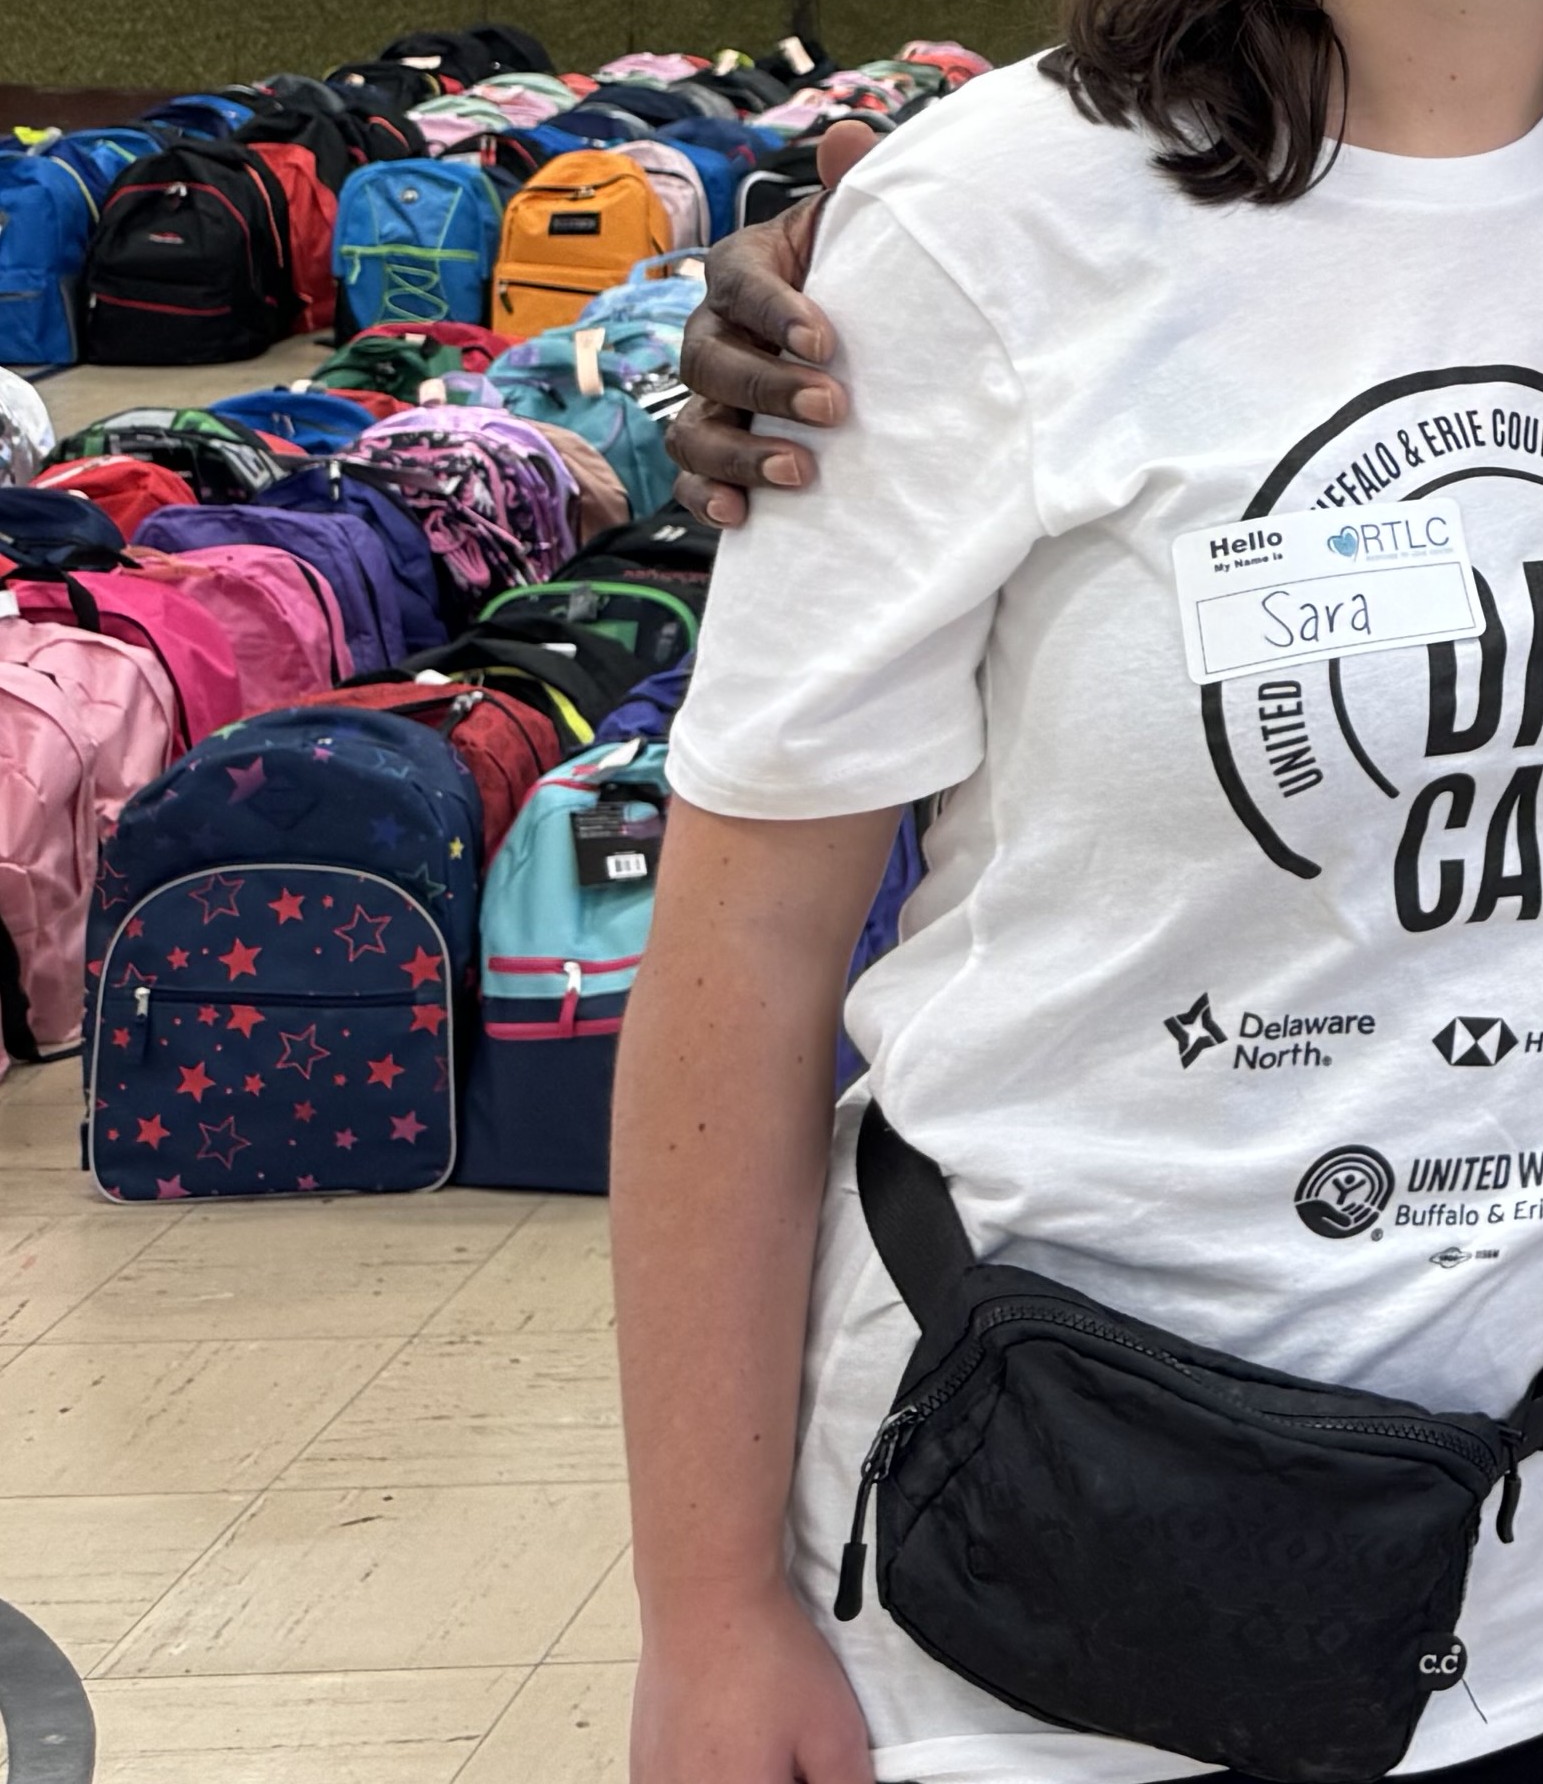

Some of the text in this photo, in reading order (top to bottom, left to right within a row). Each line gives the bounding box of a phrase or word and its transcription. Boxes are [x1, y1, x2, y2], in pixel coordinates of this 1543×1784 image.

[1210, 530, 1282, 558] Hello
[1361, 517, 1450, 554] RTLC
[1214, 562, 1230, 572] My
[1234, 556, 1270, 568] Name
[1257, 680, 1324, 798] UNITED
[1397, 430, 1425, 467] &
[1418, 410, 1485, 457] ERIE
[1262, 590, 1371, 648] Sara
[1239, 1010, 1376, 1039] Delaware
[1233, 1040, 1322, 1070] North
[1406, 1154, 1513, 1193] UNITED
[1393, 1200, 1481, 1228] Buffalo
[1487, 1200, 1507, 1223] &
